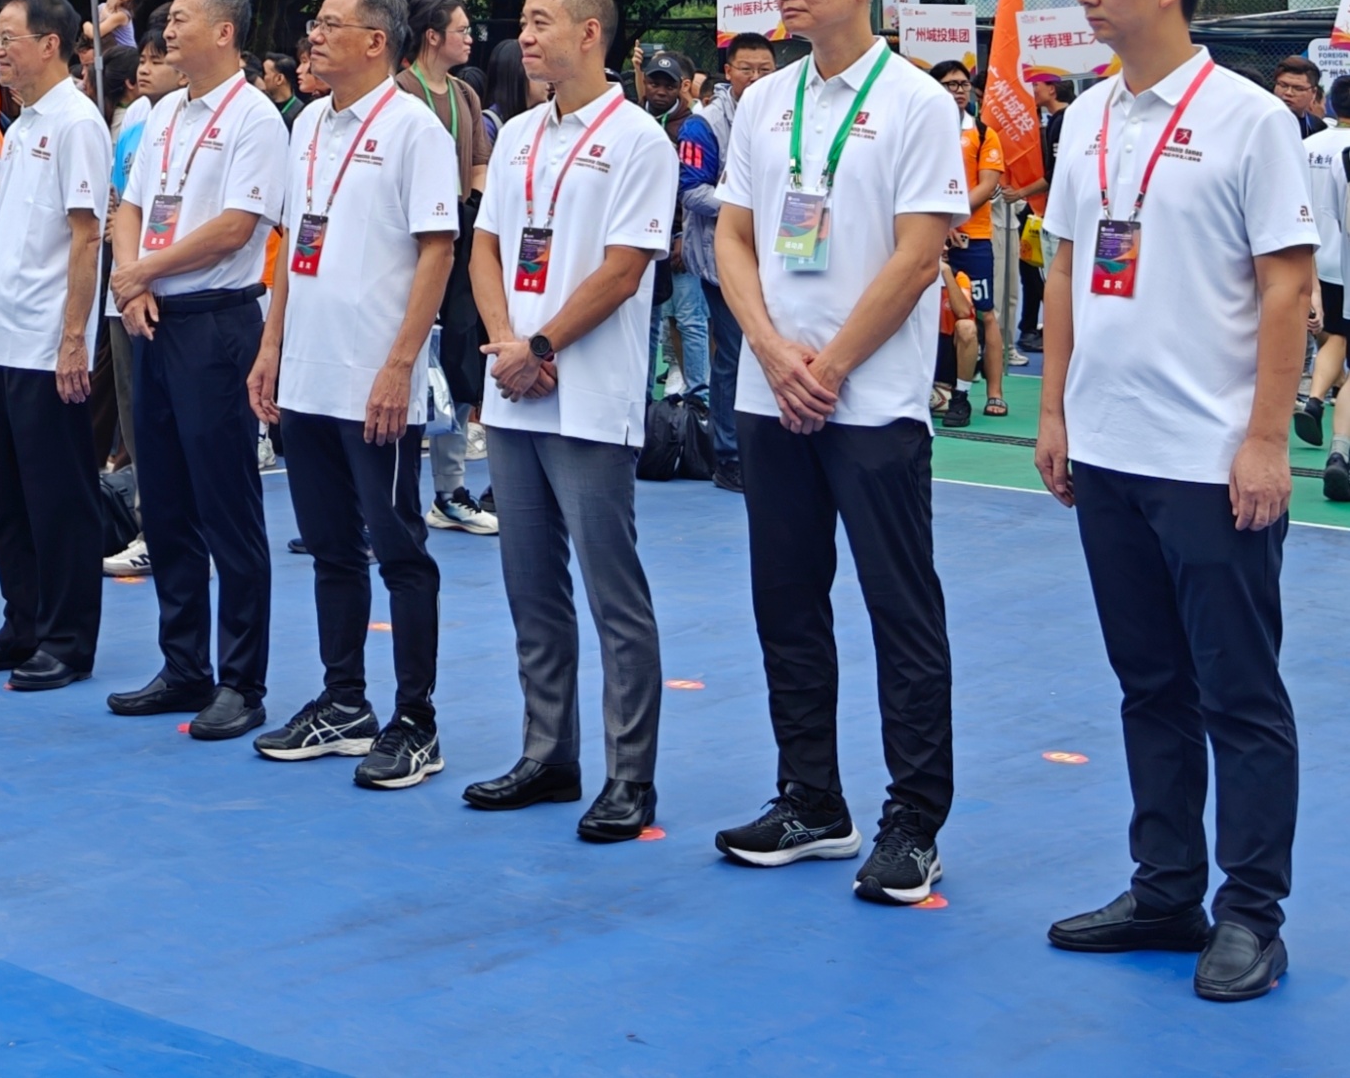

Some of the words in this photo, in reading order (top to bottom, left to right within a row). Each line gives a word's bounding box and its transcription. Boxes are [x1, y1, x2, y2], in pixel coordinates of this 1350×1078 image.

[905, 27, 970, 43] 广州城投集团
[991, 106, 1020, 141] GROUP
[971, 279, 989, 300] 51
